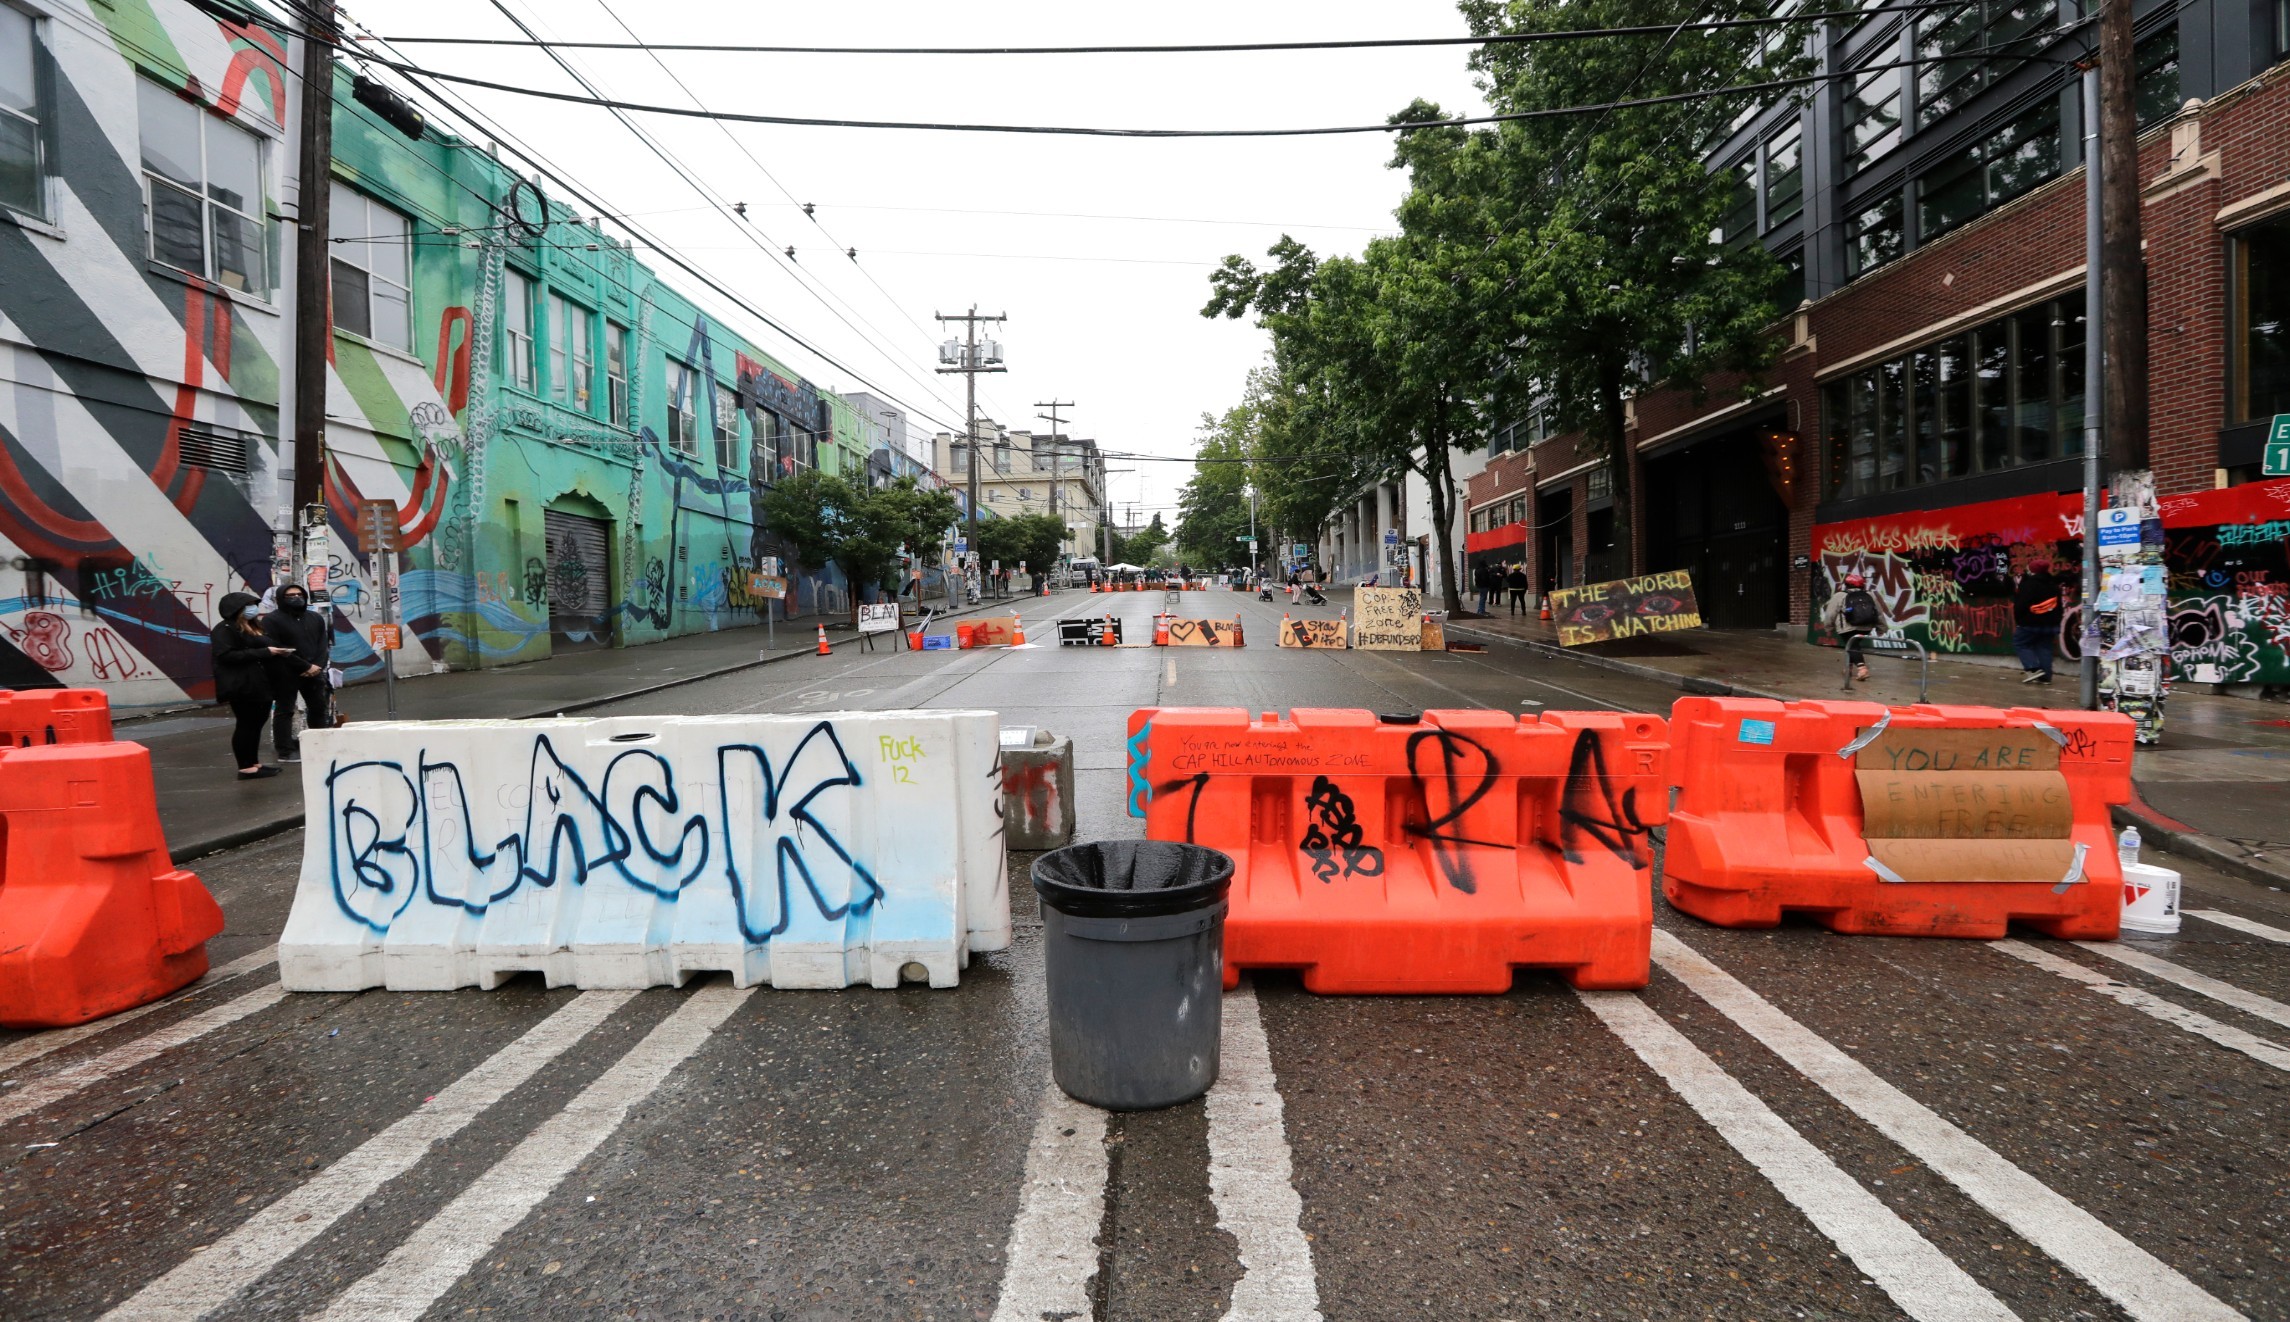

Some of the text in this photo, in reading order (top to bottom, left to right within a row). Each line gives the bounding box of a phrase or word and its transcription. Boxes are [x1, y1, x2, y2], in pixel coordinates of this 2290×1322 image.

[1552, 571, 1692, 608] THE WORLD
[2113, 583, 2133, 592] NO
[861, 604, 897, 623] BLM
[1365, 606, 1395, 617] FREE
[1562, 613, 1702, 647] IS WATCHING
[1180, 735, 1202, 753] You
[1202, 741, 1220, 751] are
[1223, 740, 1242, 750] now
[1295, 740, 1314, 752] the
[1172, 753, 1207, 770] CAP
[1211, 753, 1243, 767] HILL
[1324, 753, 1373, 768] ZONE
[1885, 745, 2037, 771] YOU ARE
[892, 764, 919, 785] 12
[1886, 781, 2063, 805] ENTERING
[326, 720, 886, 945] BLACK
[1938, 809, 2029, 834] FREE
